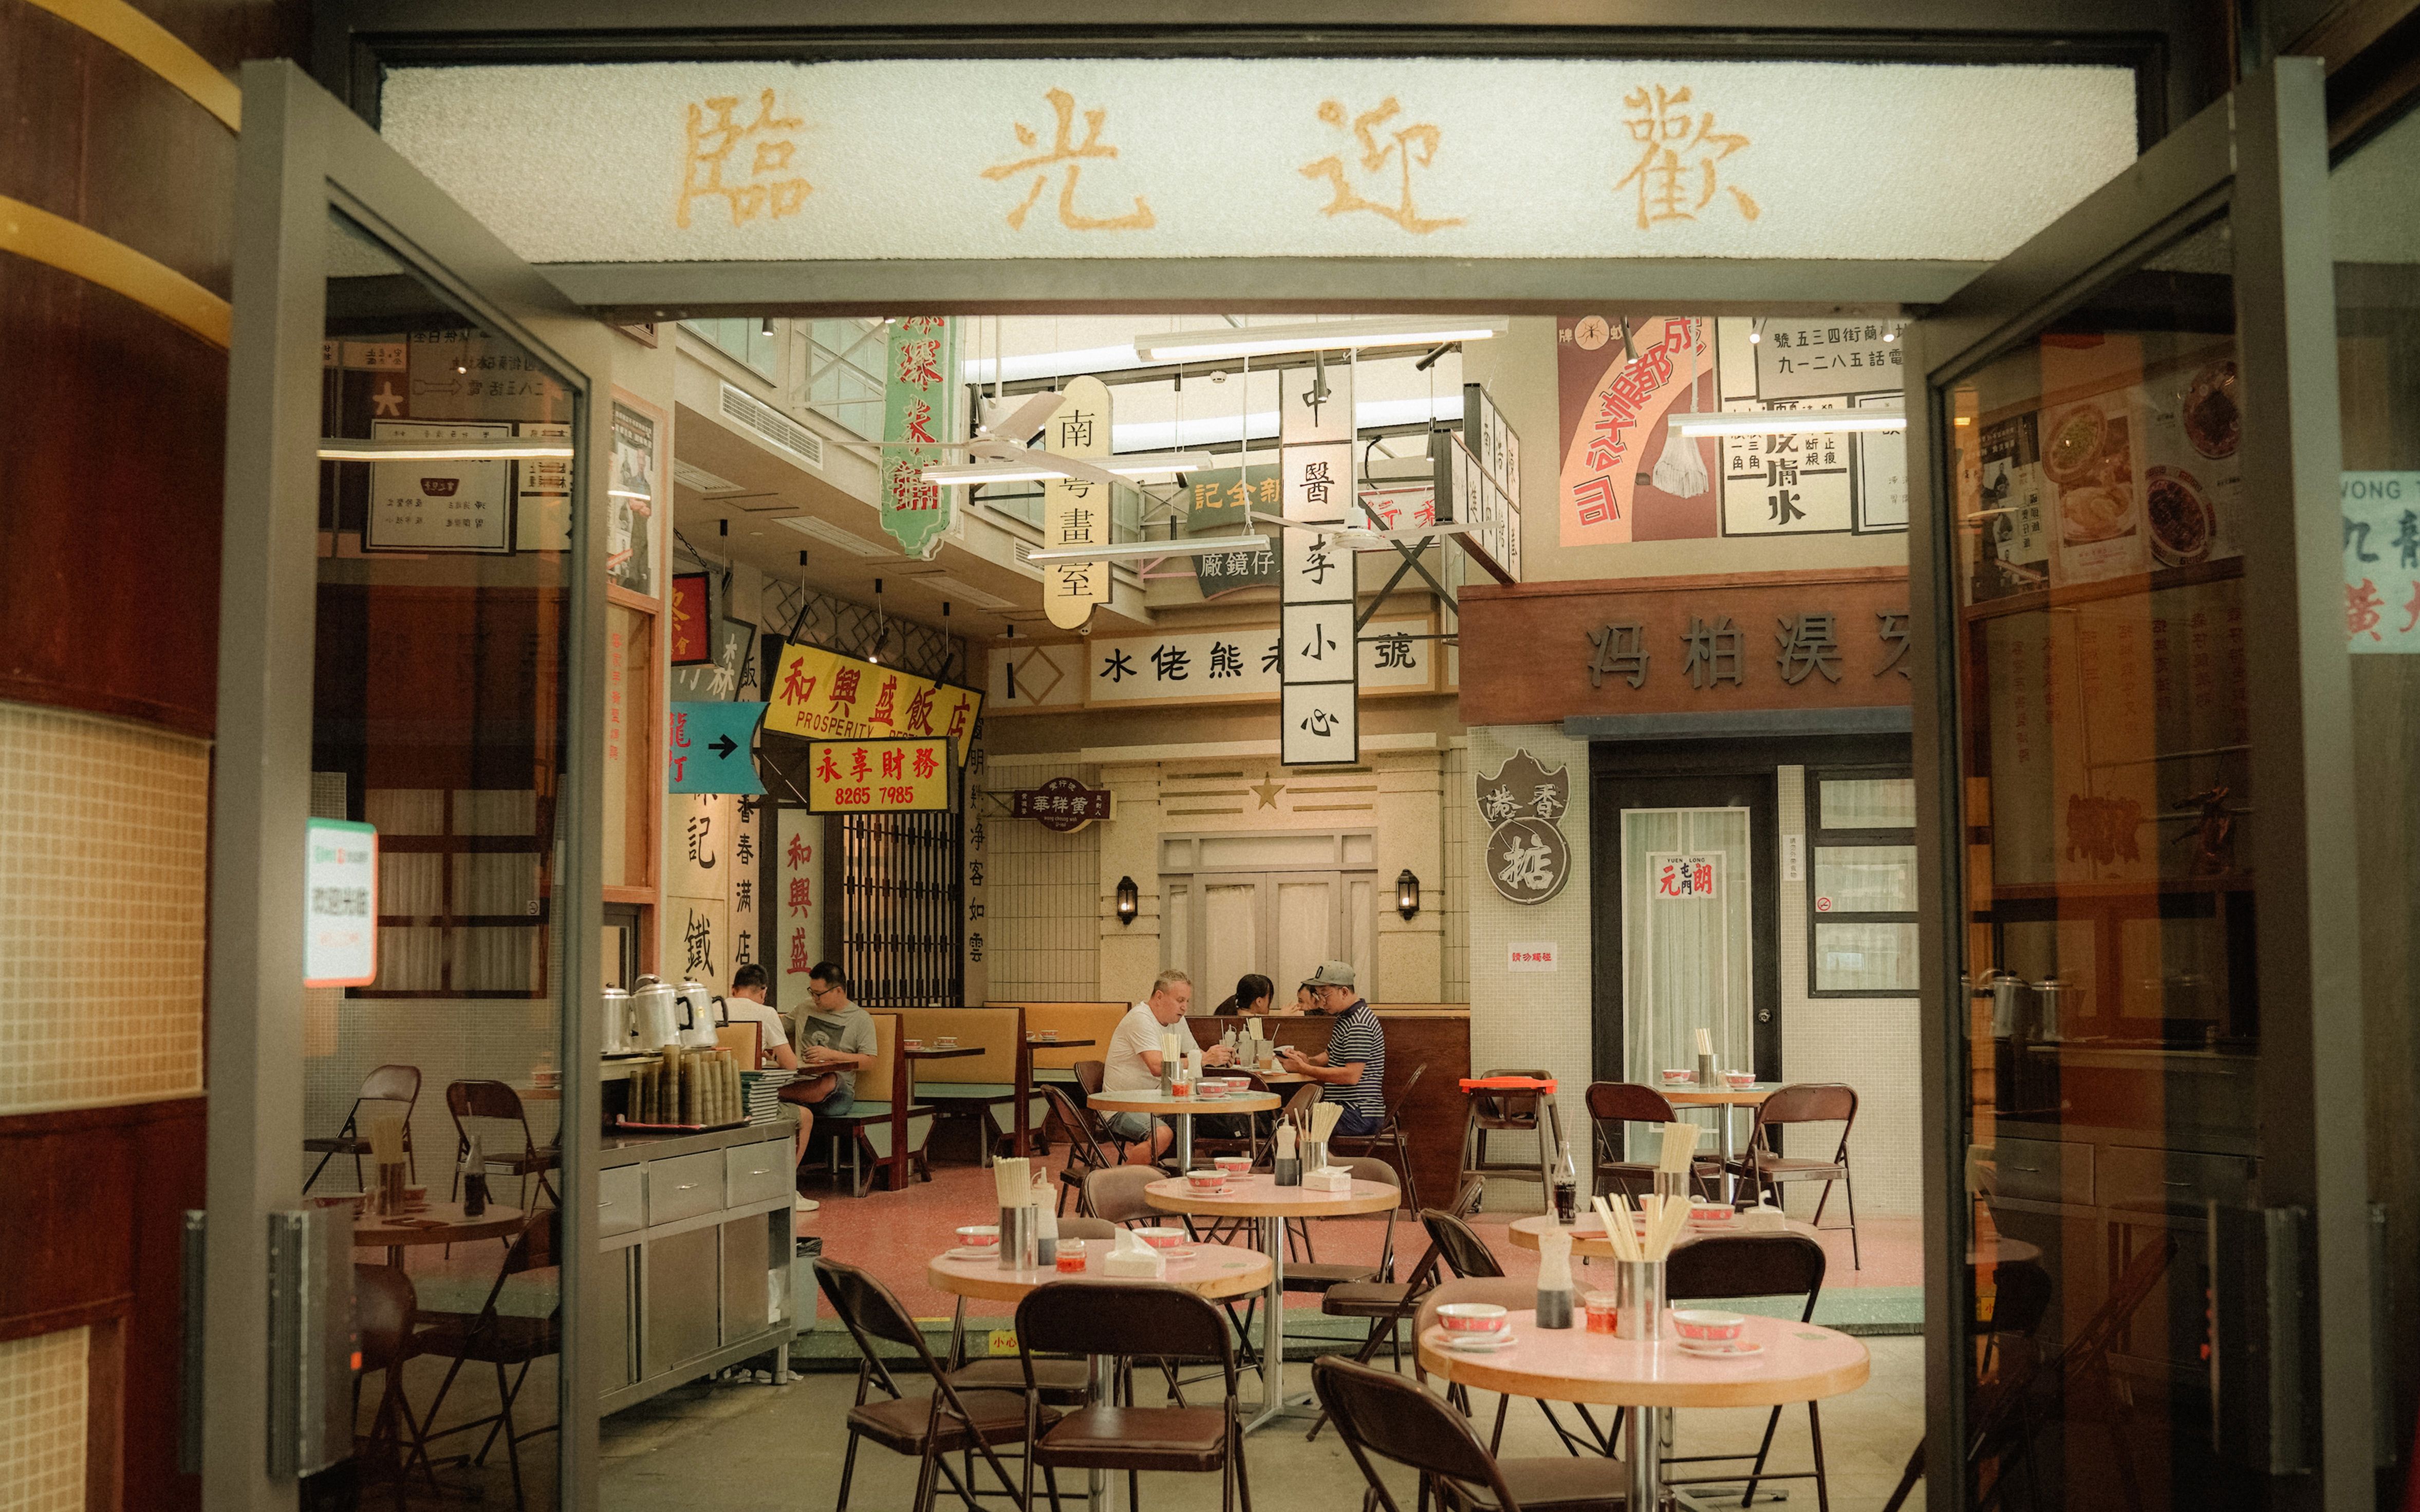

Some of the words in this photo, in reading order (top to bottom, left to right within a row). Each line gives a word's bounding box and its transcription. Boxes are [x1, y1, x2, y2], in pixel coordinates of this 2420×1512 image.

[1200, 551, 1280, 577] 仔鏡廠
[795, 711, 875, 739] PROSPERITY
[835, 786, 870, 805] 8265
[879, 786, 914, 804] 7985
[787, 832, 812, 975] 和興盛
[993, 1336, 1018, 1348] 小心
